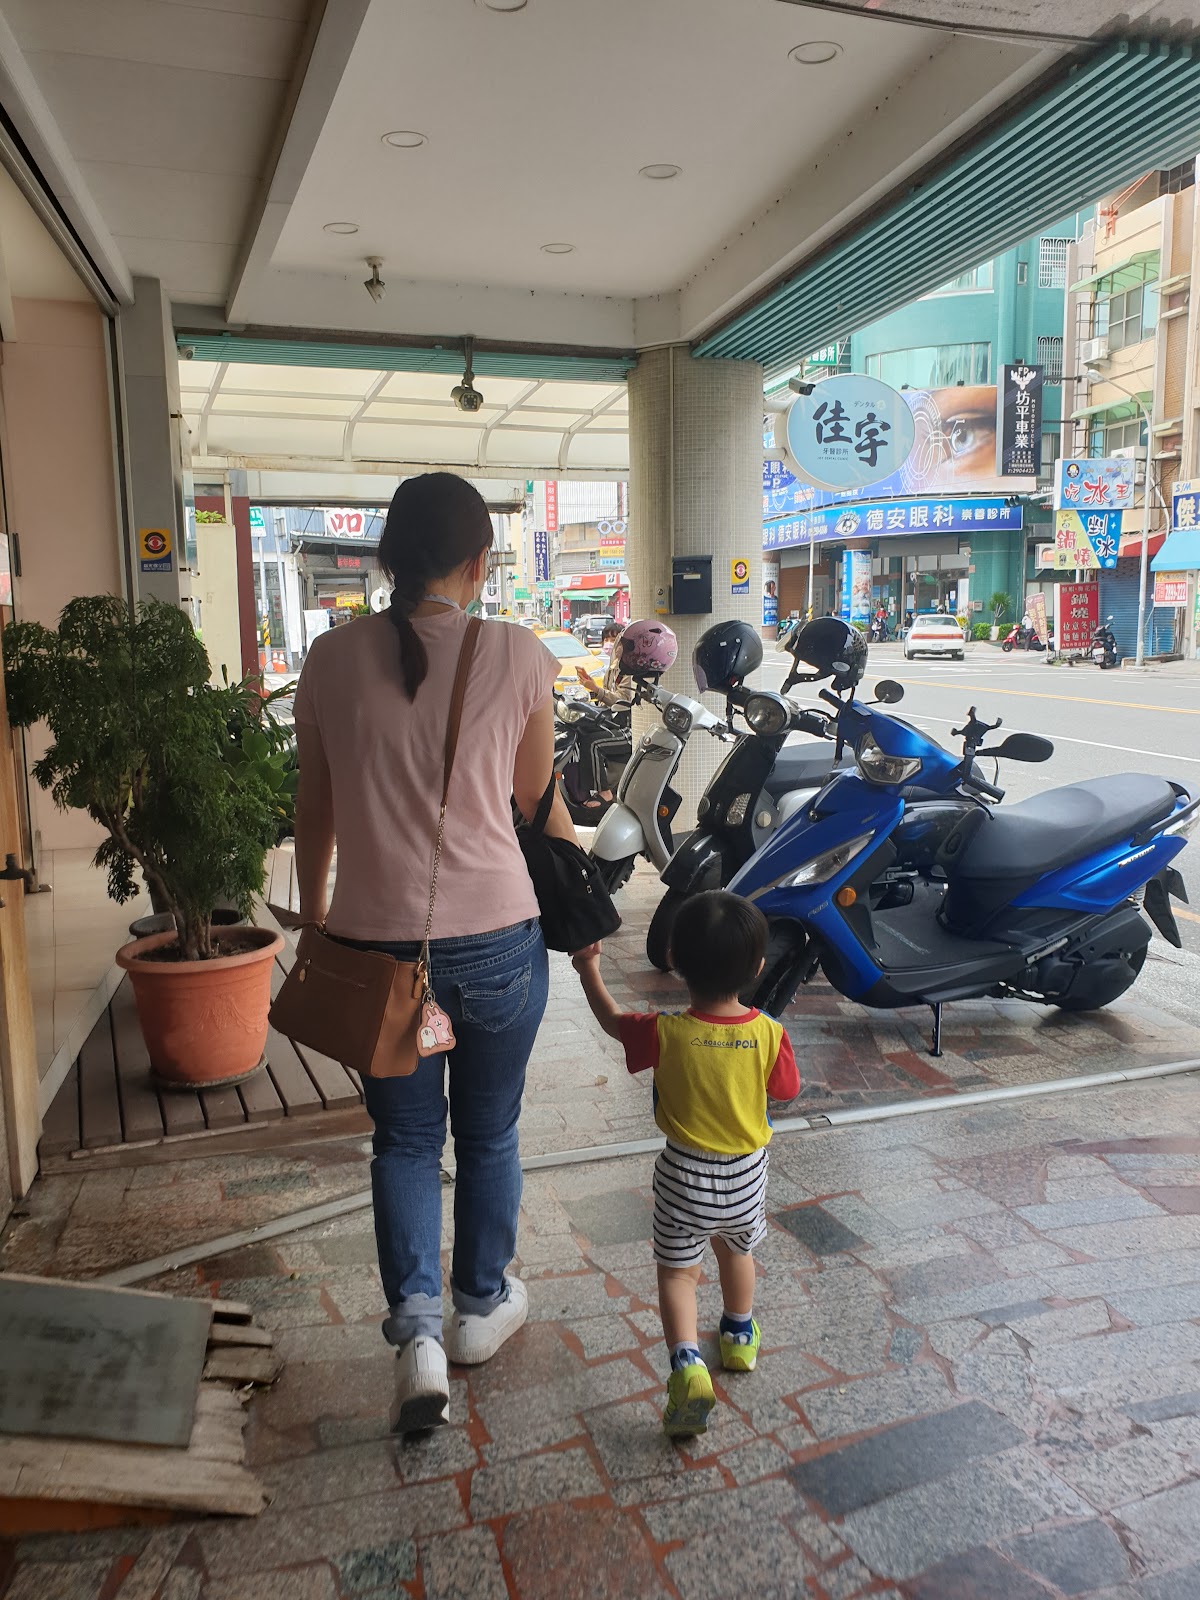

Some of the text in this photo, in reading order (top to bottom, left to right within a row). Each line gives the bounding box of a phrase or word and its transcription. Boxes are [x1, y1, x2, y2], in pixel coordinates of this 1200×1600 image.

[1015, 391, 1031, 449] 坊平車業
[822, 447, 849, 455] 牙醫診所
[866, 504, 955, 531] 德安眼科
[961, 508, 1011, 521] 崇善診所
[1176, 497, 1200, 528] 傑
[703, 1038, 758, 1050] ROBOCAR POLI
